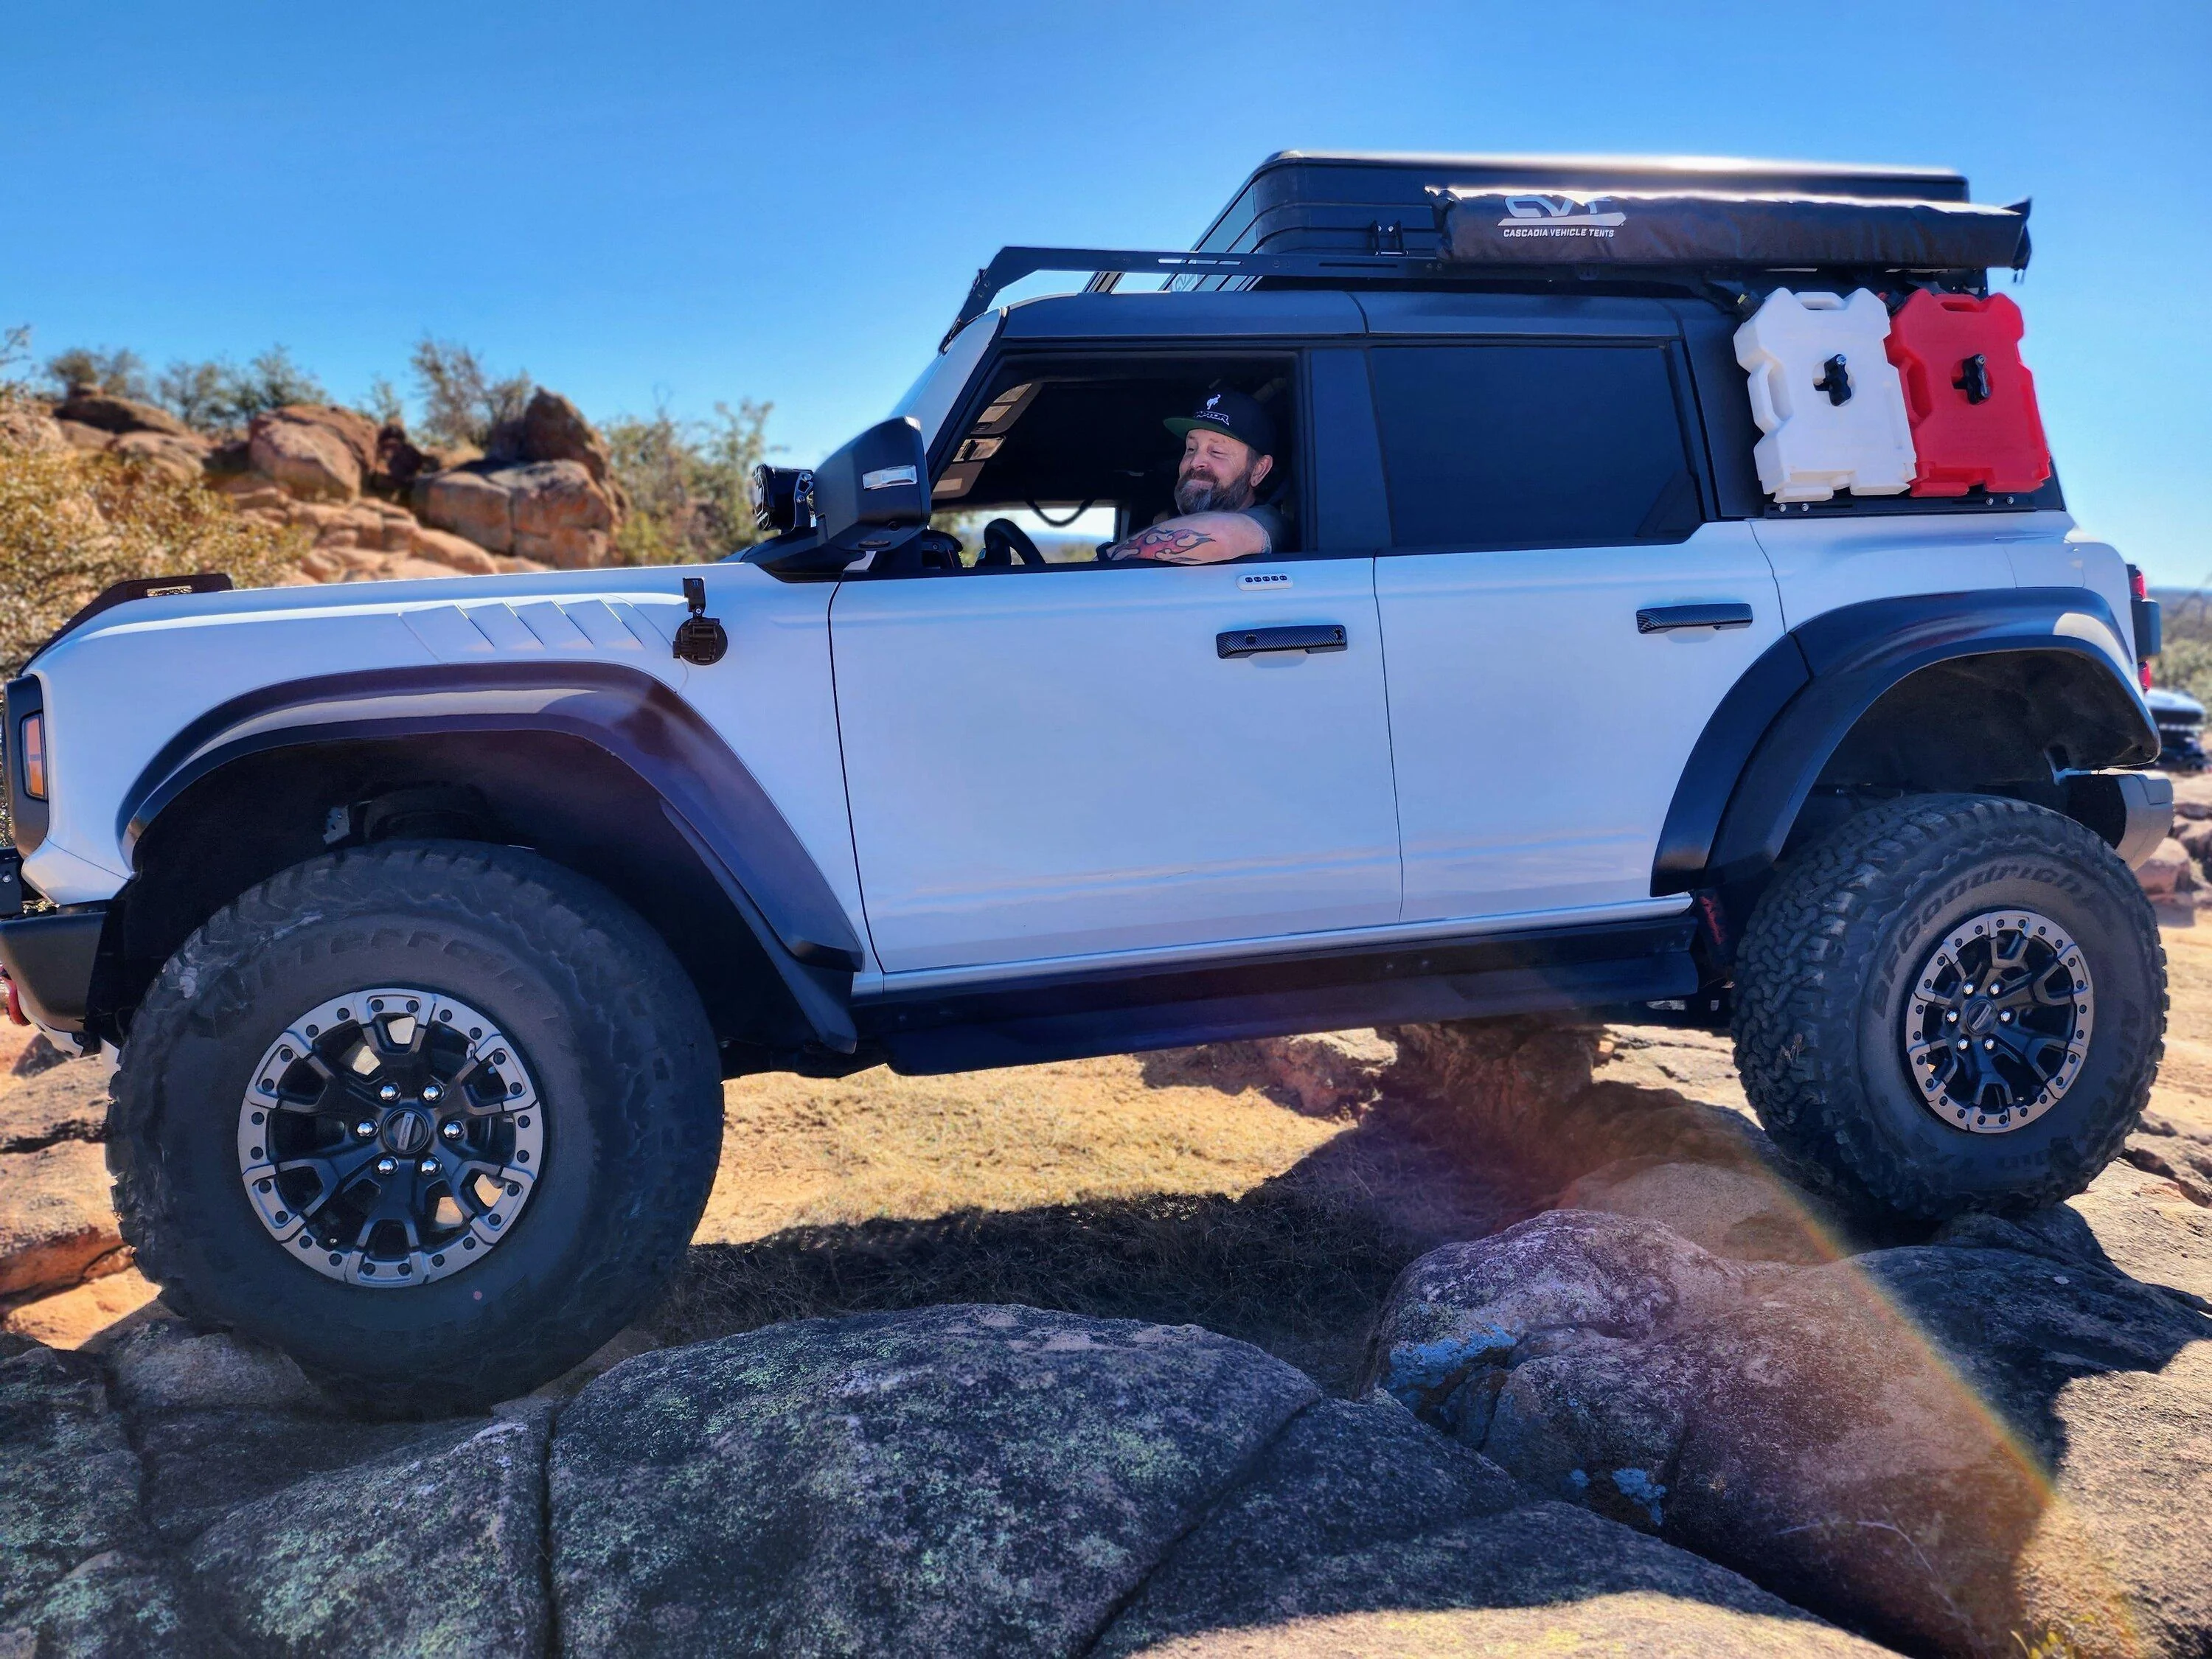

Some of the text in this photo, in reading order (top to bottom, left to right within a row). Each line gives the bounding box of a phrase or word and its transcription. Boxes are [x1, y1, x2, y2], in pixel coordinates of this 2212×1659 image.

[1503, 228, 1615, 238] CASCADIA VEHICLE TENTS
